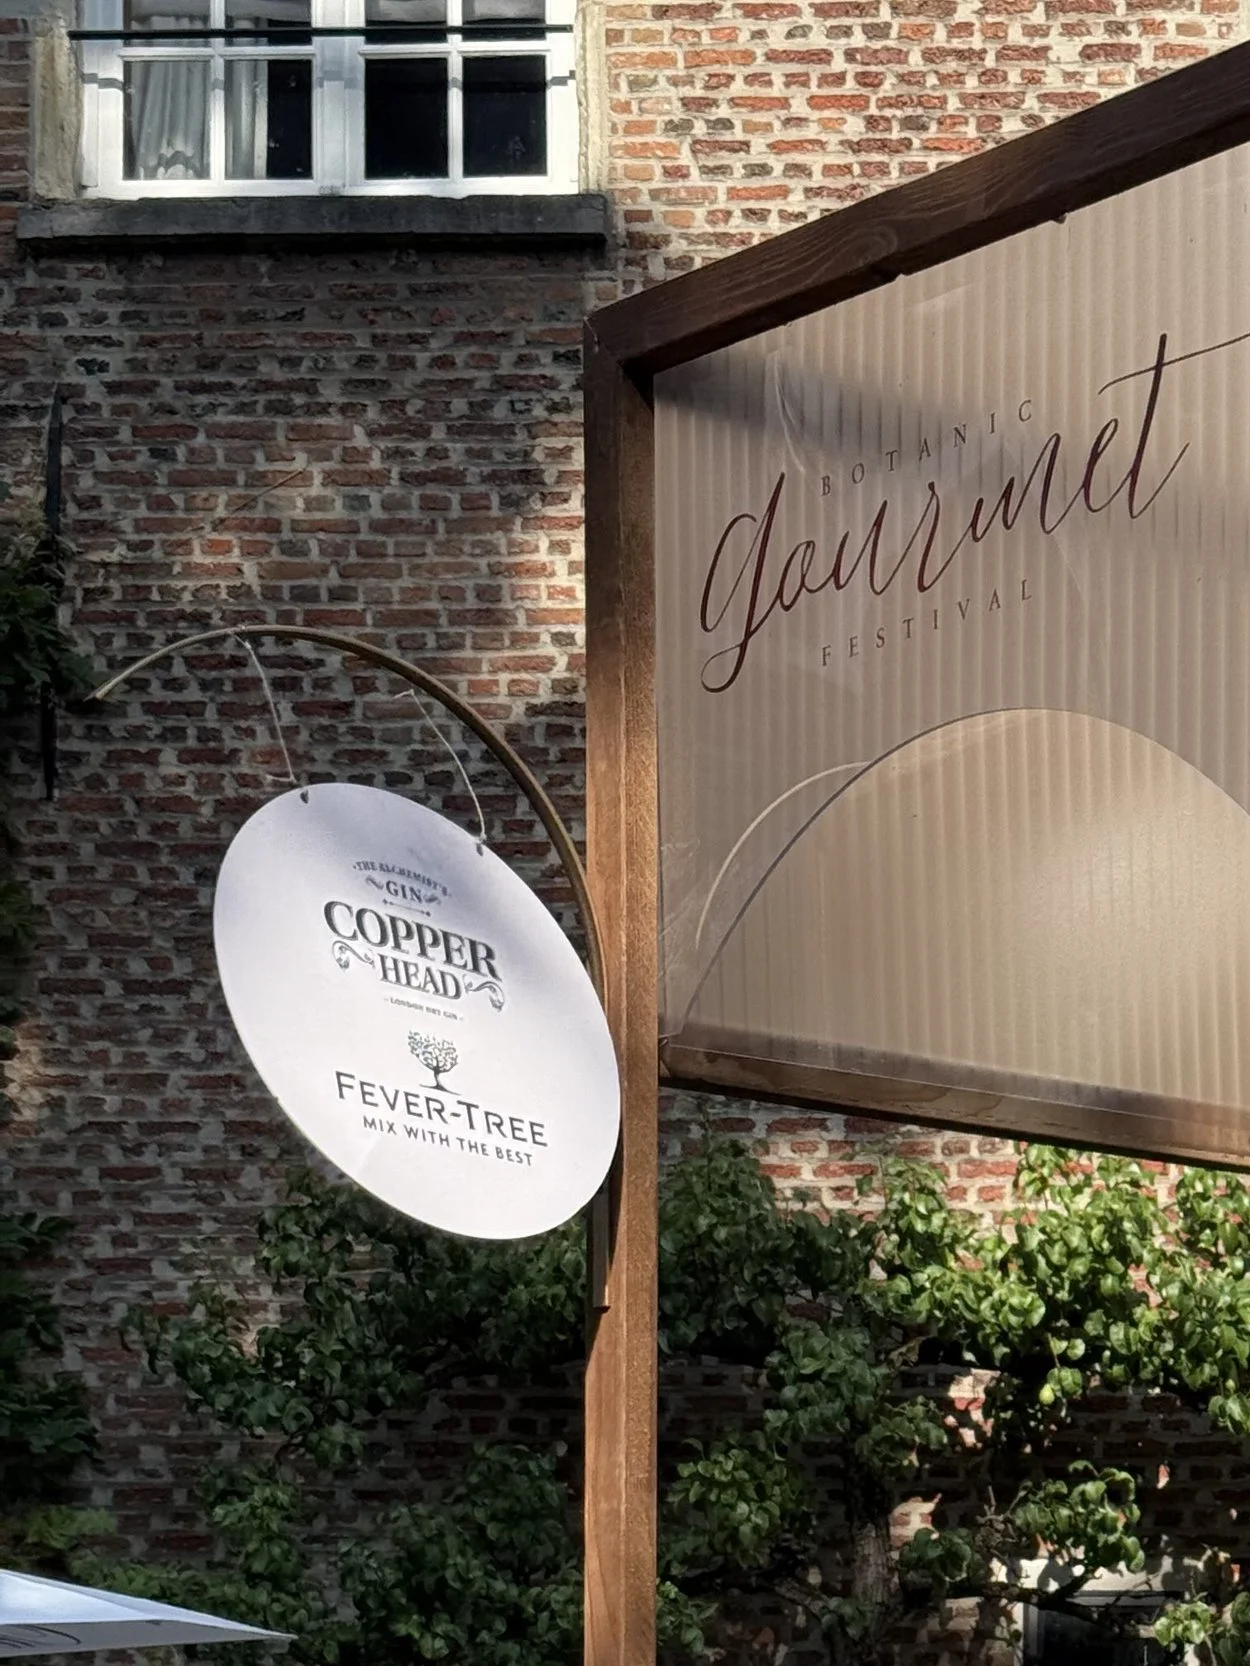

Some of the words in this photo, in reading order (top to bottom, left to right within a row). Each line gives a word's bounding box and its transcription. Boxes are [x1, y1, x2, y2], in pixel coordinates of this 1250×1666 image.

[820, 399, 1033, 497] BOTANIC
[820, 578, 1033, 667] FESTIVAL
[385, 880, 423, 903] GIN
[323, 900, 503, 983] COPPER
[377, 953, 462, 1000] HEAD
[335, 1070, 548, 1147] FEVER-TREE
[362, 1115, 397, 1135] MIX
[404, 1124, 450, 1148] WITH
[456, 1137, 490, 1157] THE
[495, 1146, 533, 1167] BEST
